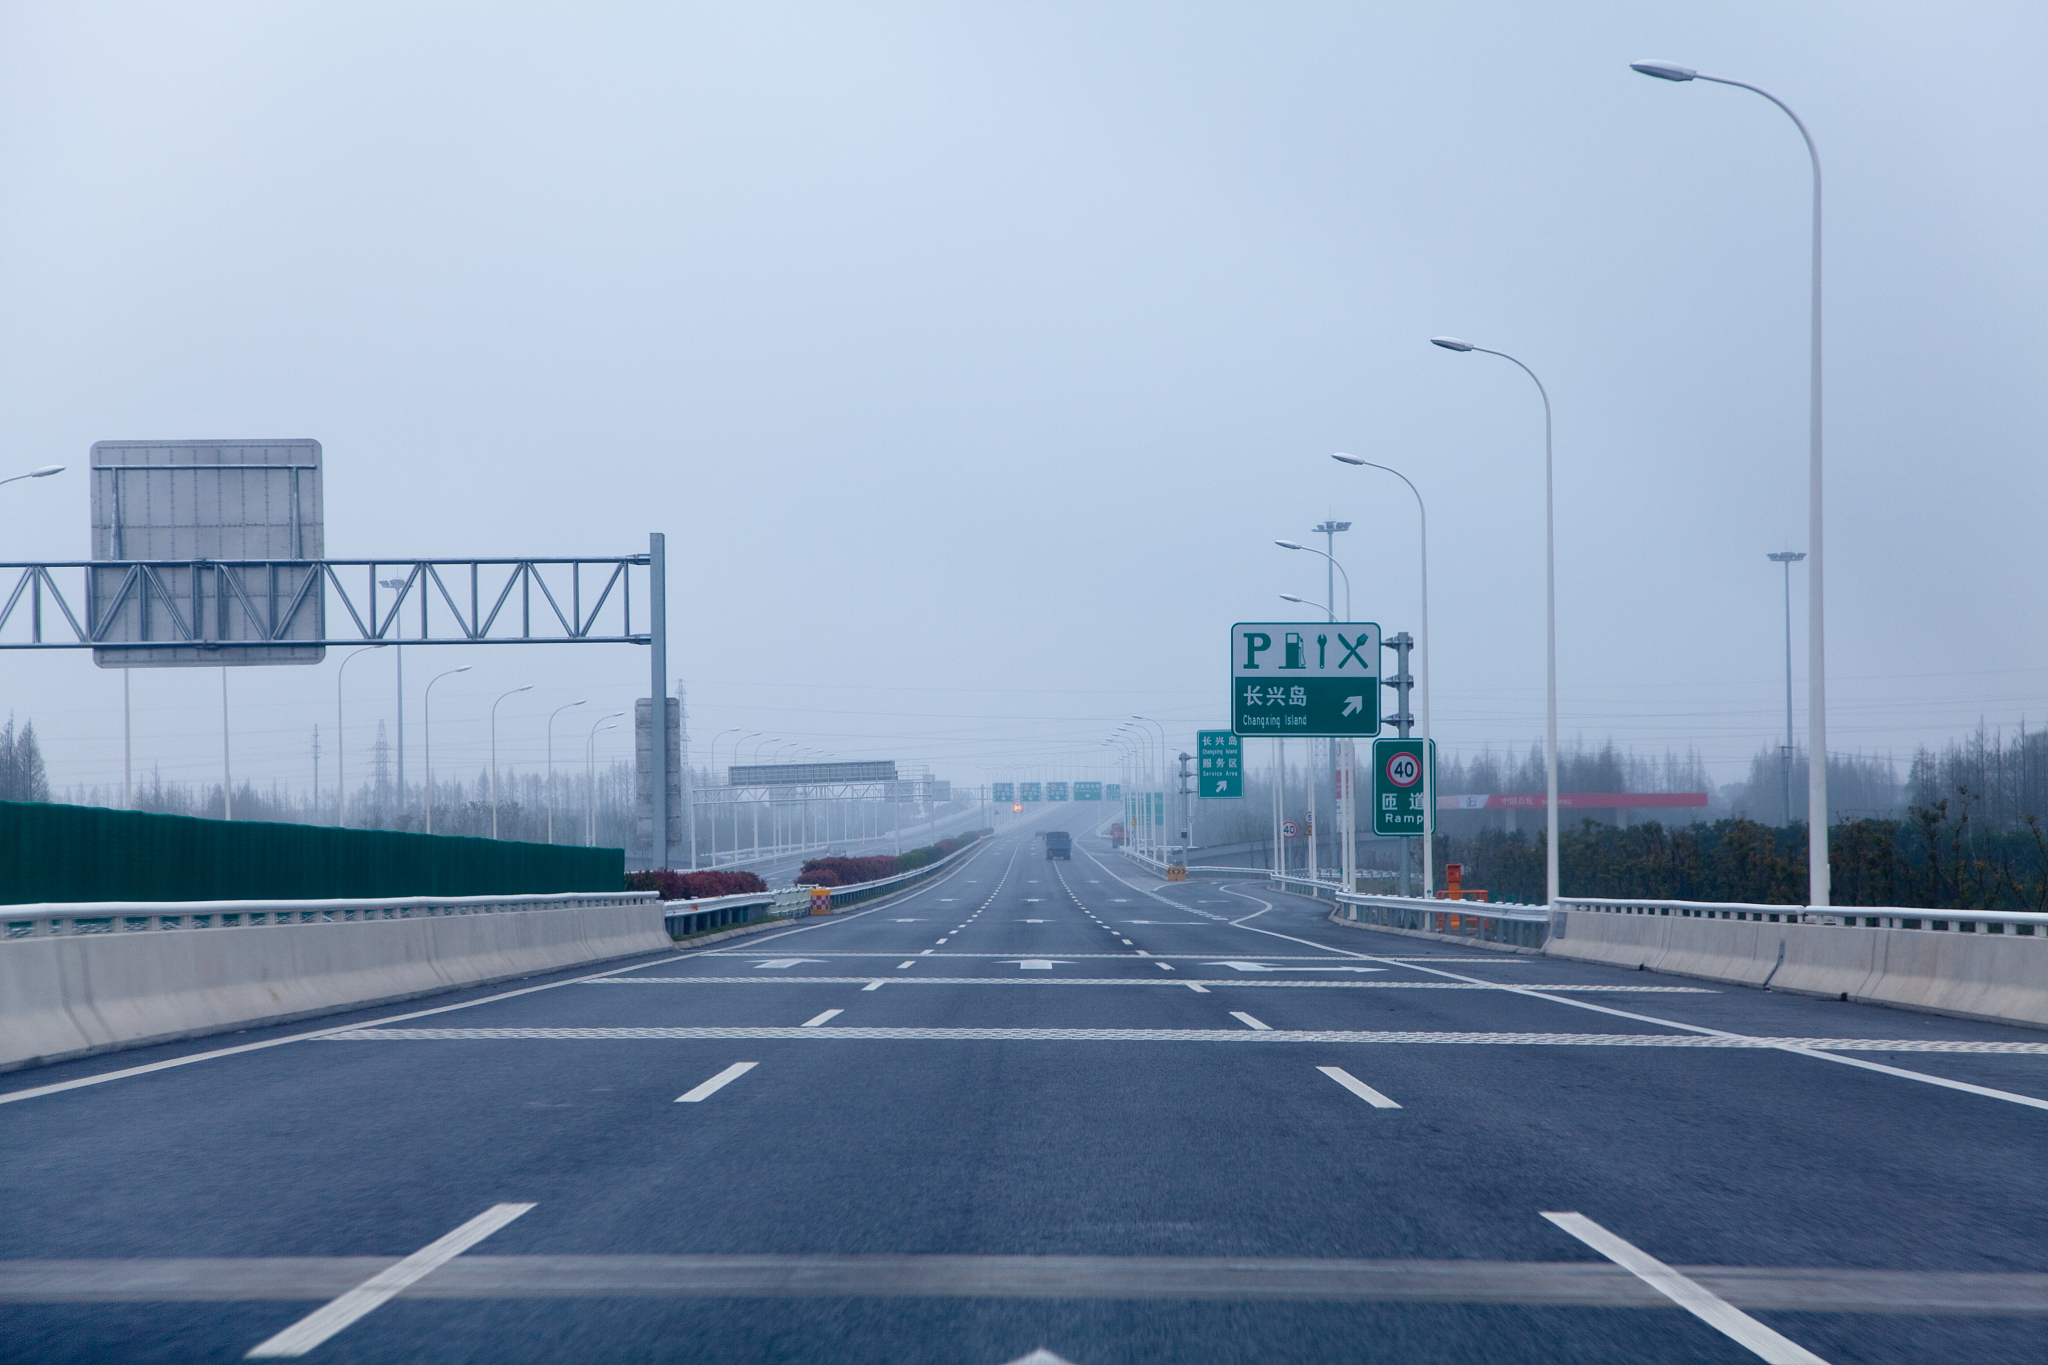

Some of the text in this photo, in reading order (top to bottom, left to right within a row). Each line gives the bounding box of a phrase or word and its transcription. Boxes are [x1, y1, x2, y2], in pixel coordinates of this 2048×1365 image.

[1243, 633, 1271, 669] P
[1243, 685, 1307, 707] 长兴岛
[1243, 714, 1307, 729] Changxing Island
[1202, 735, 1238, 746] 长兴岛
[1202, 758, 1238, 768] 服务区
[1394, 761, 1414, 778] 40
[1385, 813, 1424, 825] Ramp
[1283, 825, 1295, 835] 40
